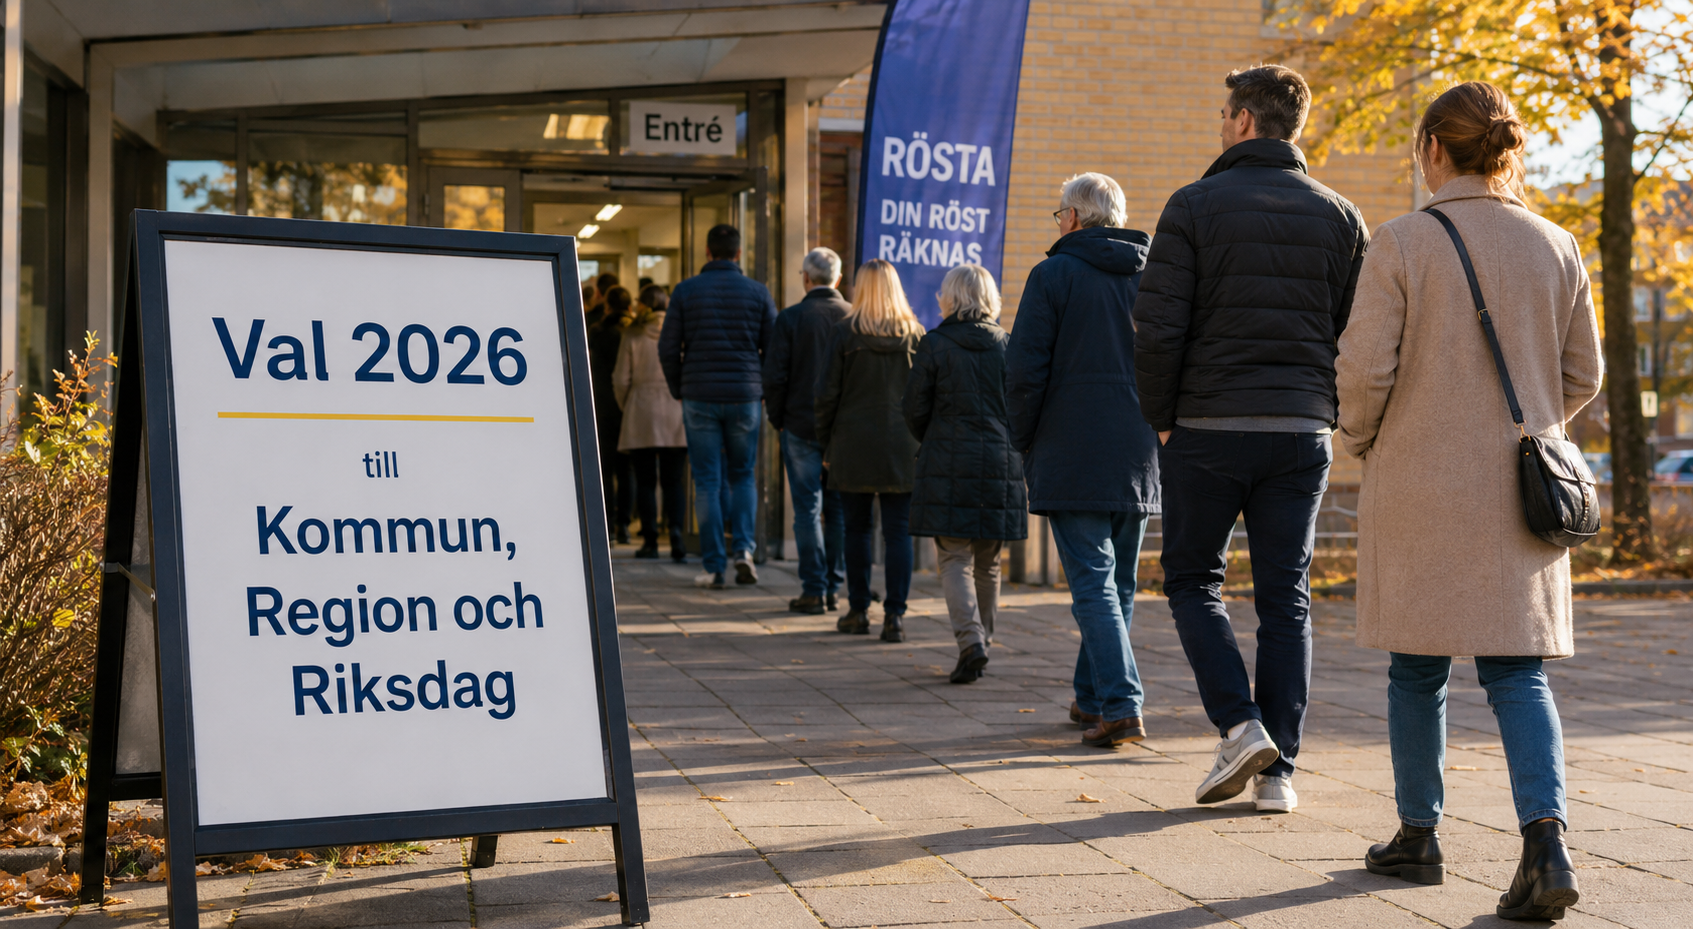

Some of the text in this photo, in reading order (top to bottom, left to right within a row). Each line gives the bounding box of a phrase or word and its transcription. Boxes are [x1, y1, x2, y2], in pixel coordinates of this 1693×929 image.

[644, 111, 723, 144] Entré
[882, 131, 996, 187] RÖSTA
[880, 199, 991, 234] DIN RÖST
[878, 230, 983, 268] RÄKNAS
[212, 317, 528, 386] Val 2026
[362, 450, 399, 479] till
[256, 505, 517, 561] Kommun,
[246, 581, 544, 648] Region och
[291, 659, 516, 720] Riksdag
